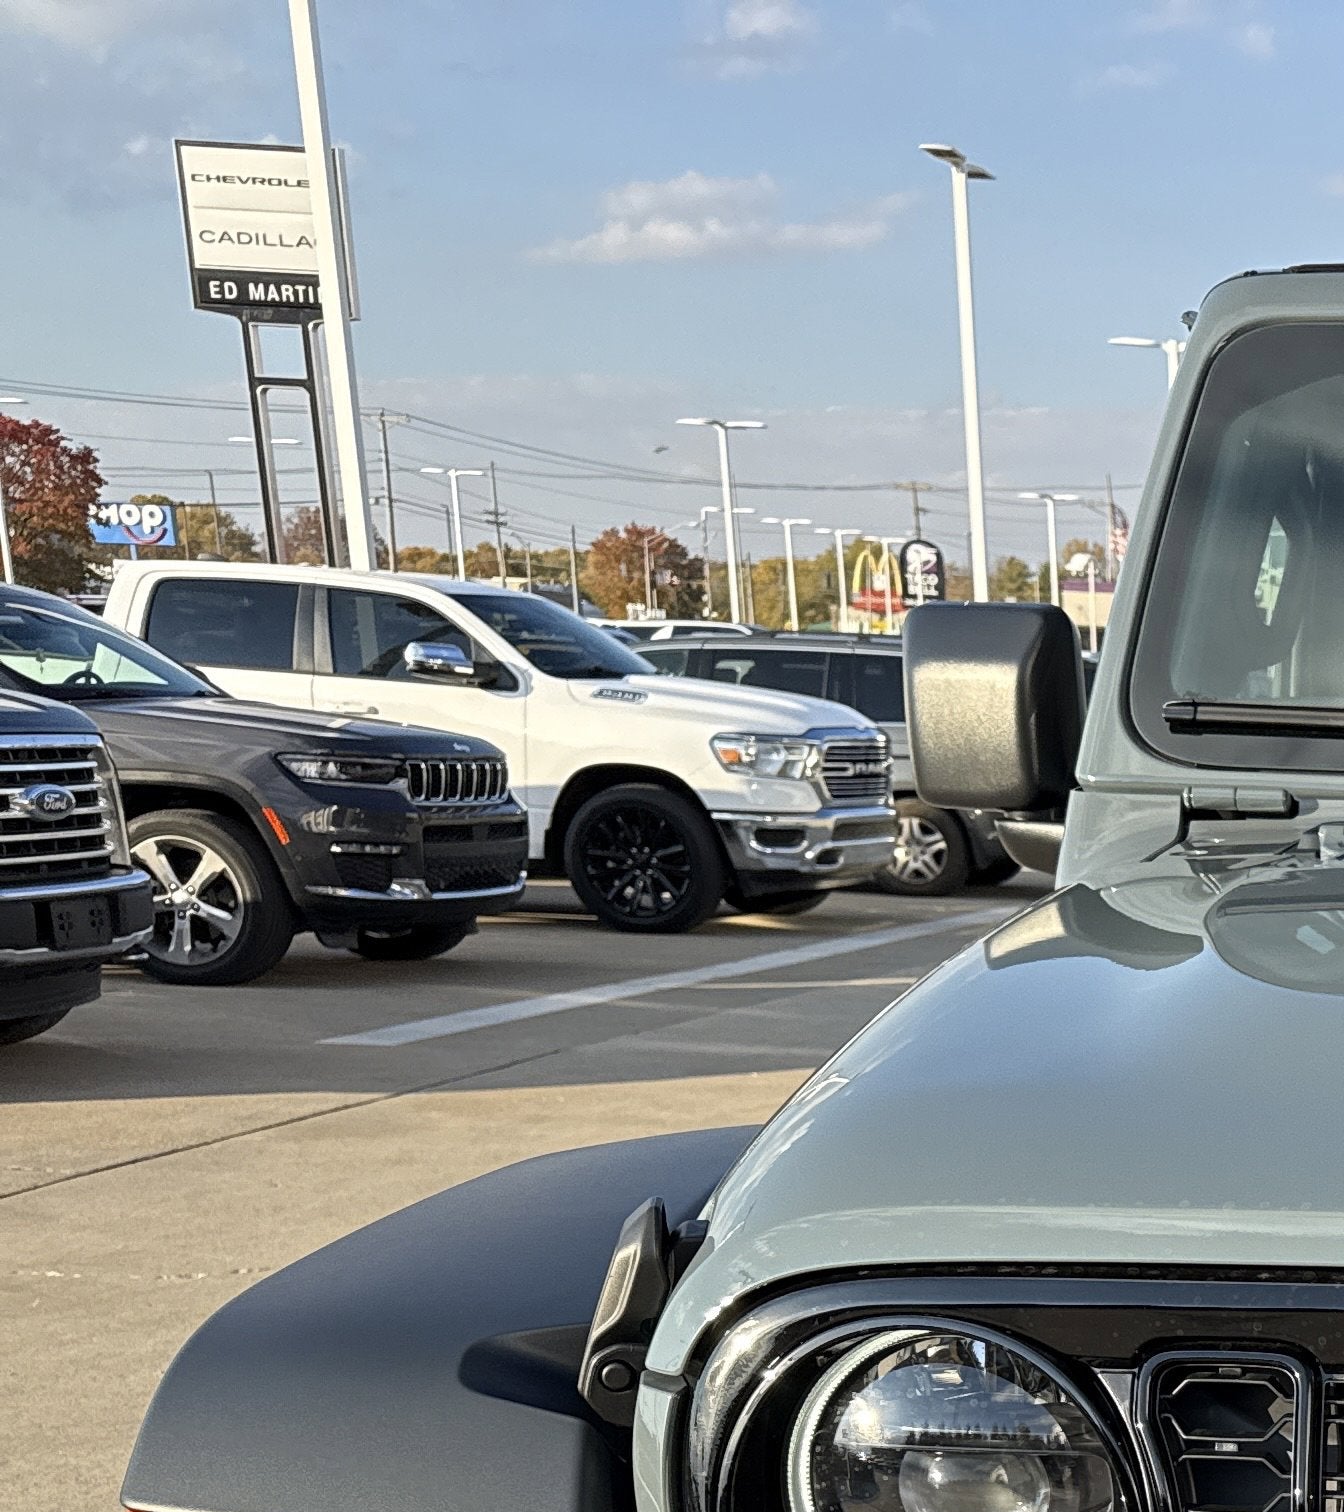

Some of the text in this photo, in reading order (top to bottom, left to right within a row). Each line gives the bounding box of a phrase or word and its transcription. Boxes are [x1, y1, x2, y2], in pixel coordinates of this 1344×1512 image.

[190, 173, 311, 189] CHEVROLE
[198, 229, 317, 250] CADILLA
[208, 280, 238, 300] ED
[44, 793, 67, 810] Ford
